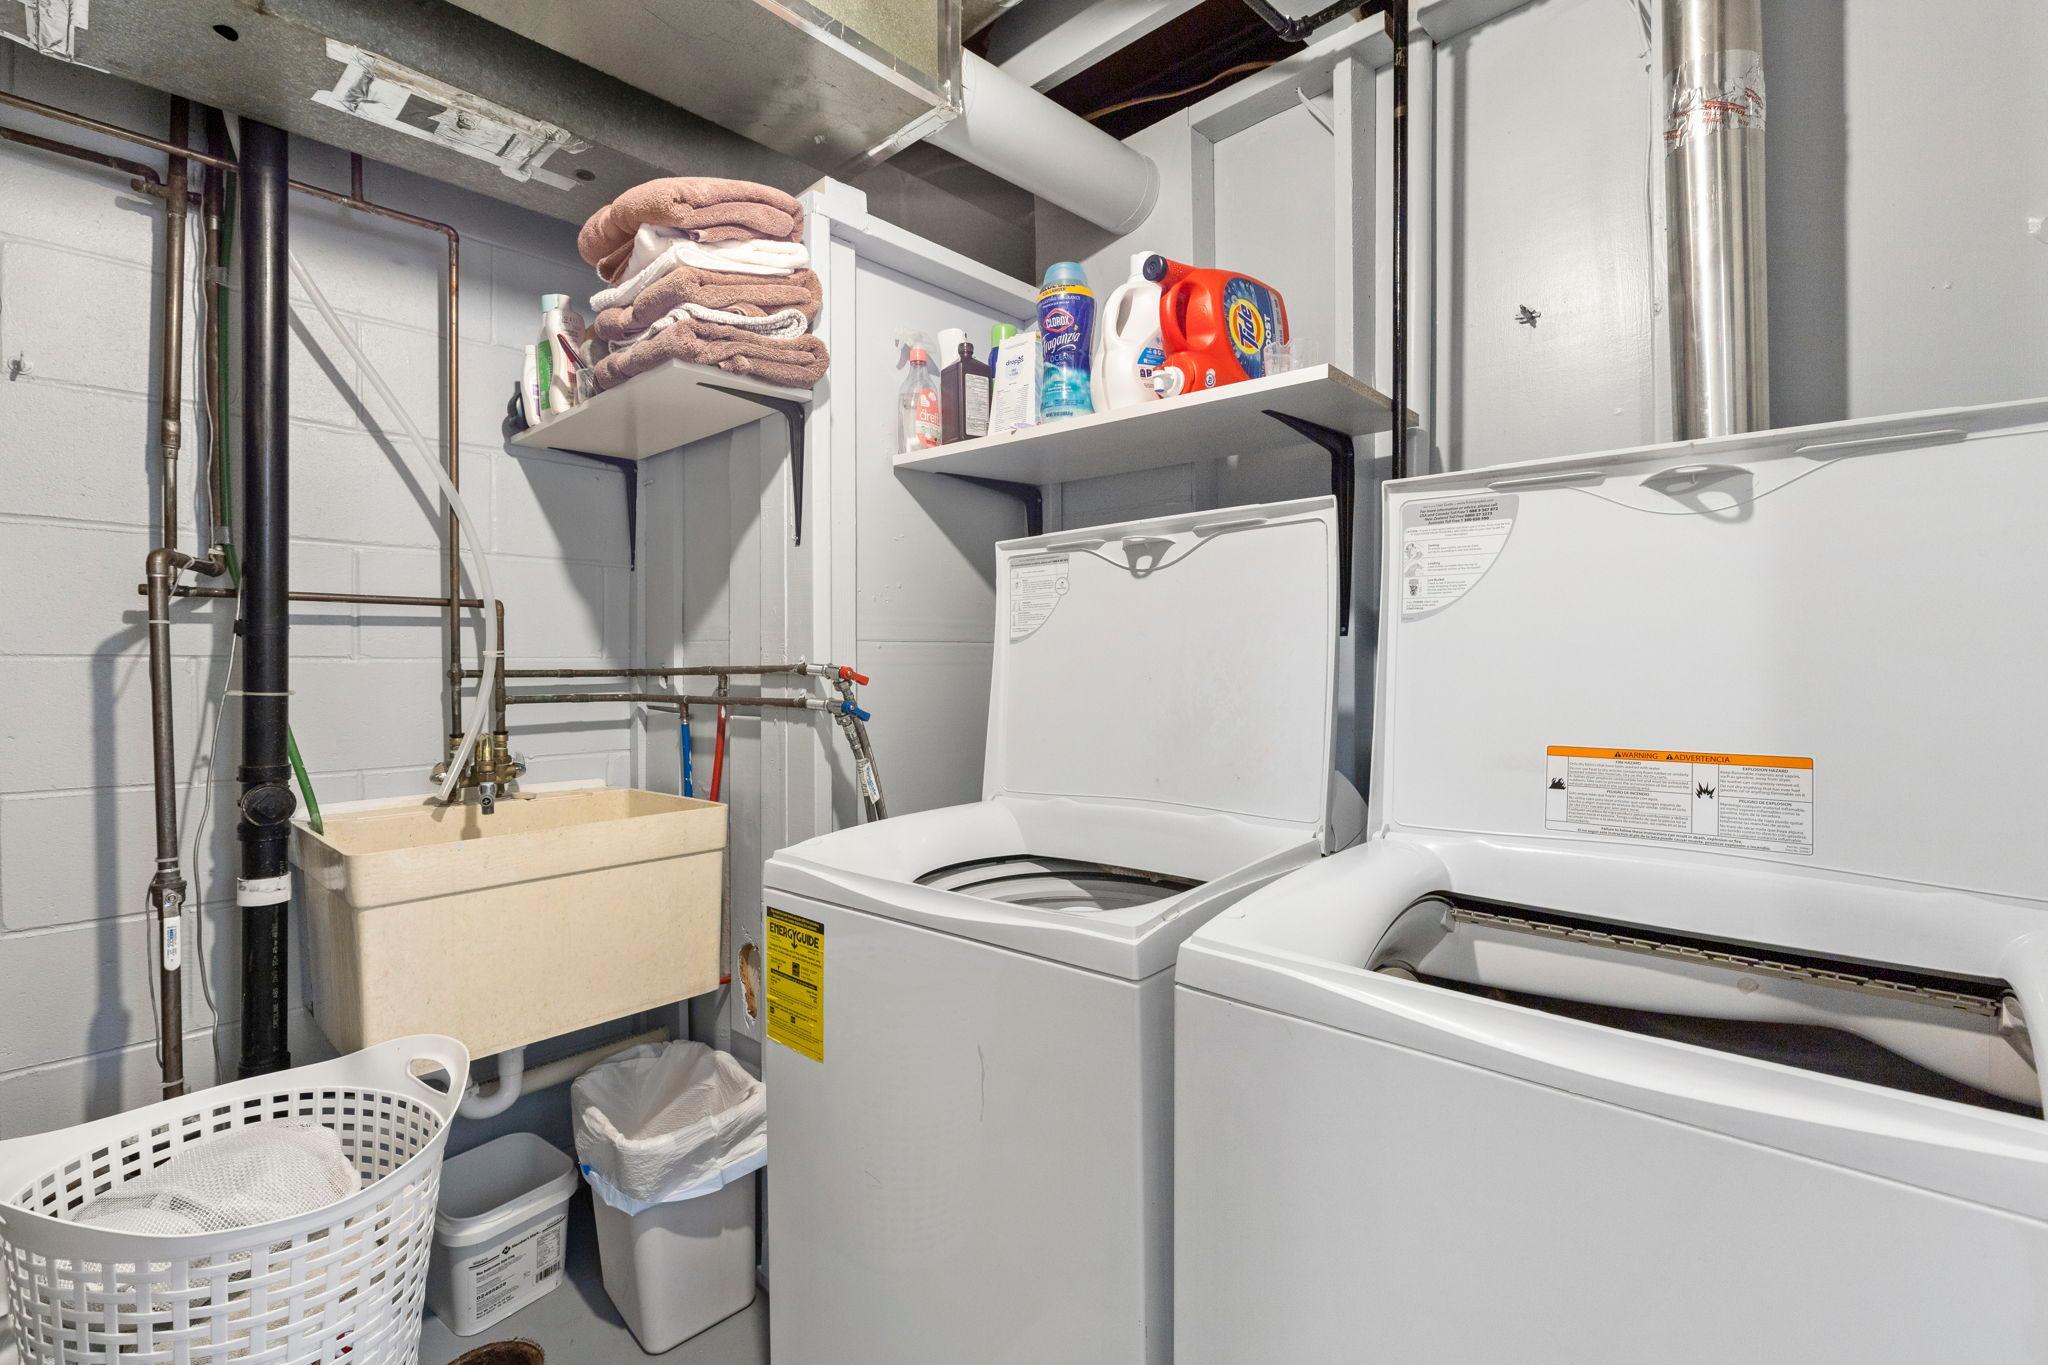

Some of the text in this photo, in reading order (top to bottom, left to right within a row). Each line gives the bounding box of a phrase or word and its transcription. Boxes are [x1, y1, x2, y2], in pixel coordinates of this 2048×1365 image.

[1045, 315, 1069, 329] CLOROX
[1238, 303, 1259, 350] Tide
[1042, 331, 1081, 356] Fraganzia
[1049, 353, 1073, 363] OCEAN
[1621, 752, 1730, 763] WARNING ADVERTENCIA
[769, 922, 819, 949] ENERGYGUIDE
